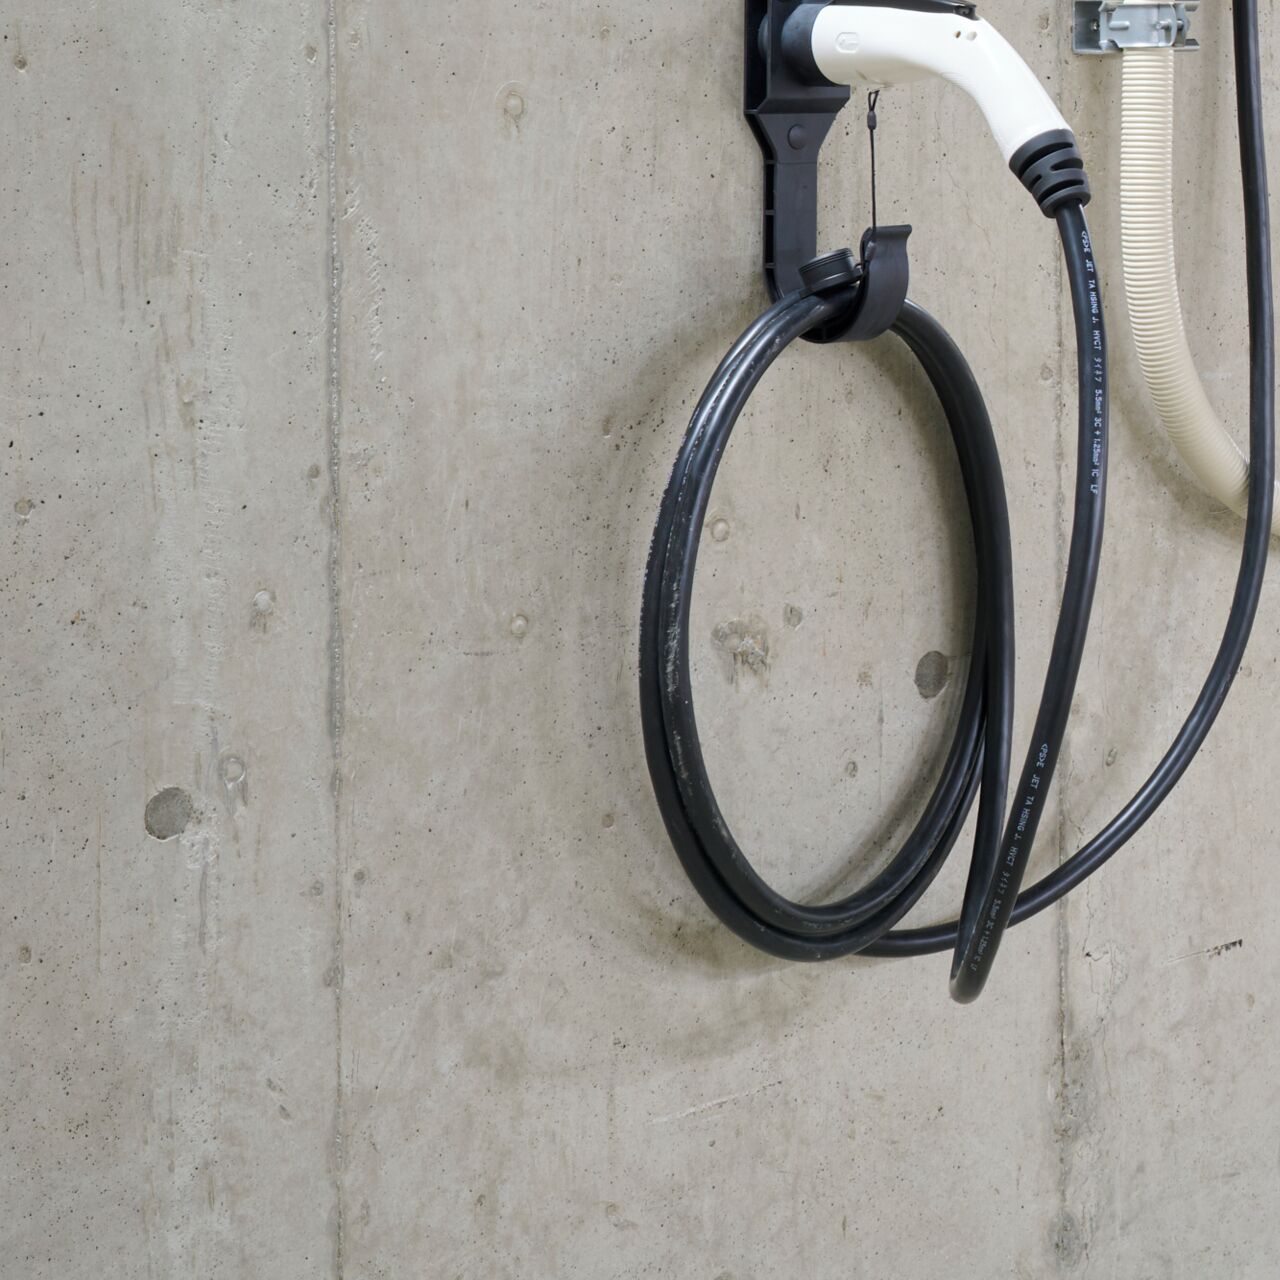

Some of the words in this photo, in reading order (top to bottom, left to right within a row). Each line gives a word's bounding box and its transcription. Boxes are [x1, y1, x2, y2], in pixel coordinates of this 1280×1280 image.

[1086, 259, 1094, 272] JET
[1088, 279, 1096, 289] TA
[1090, 291, 1099, 314] HSING
[1093, 329, 1102, 351] HVCT
[1094, 417, 1102, 428] 3C
[1090, 484, 1098, 495] LF
[1030, 774, 1040, 790] JET
[1025, 796, 1034, 805] TA
[1006, 846, 1018, 866] HVCT
